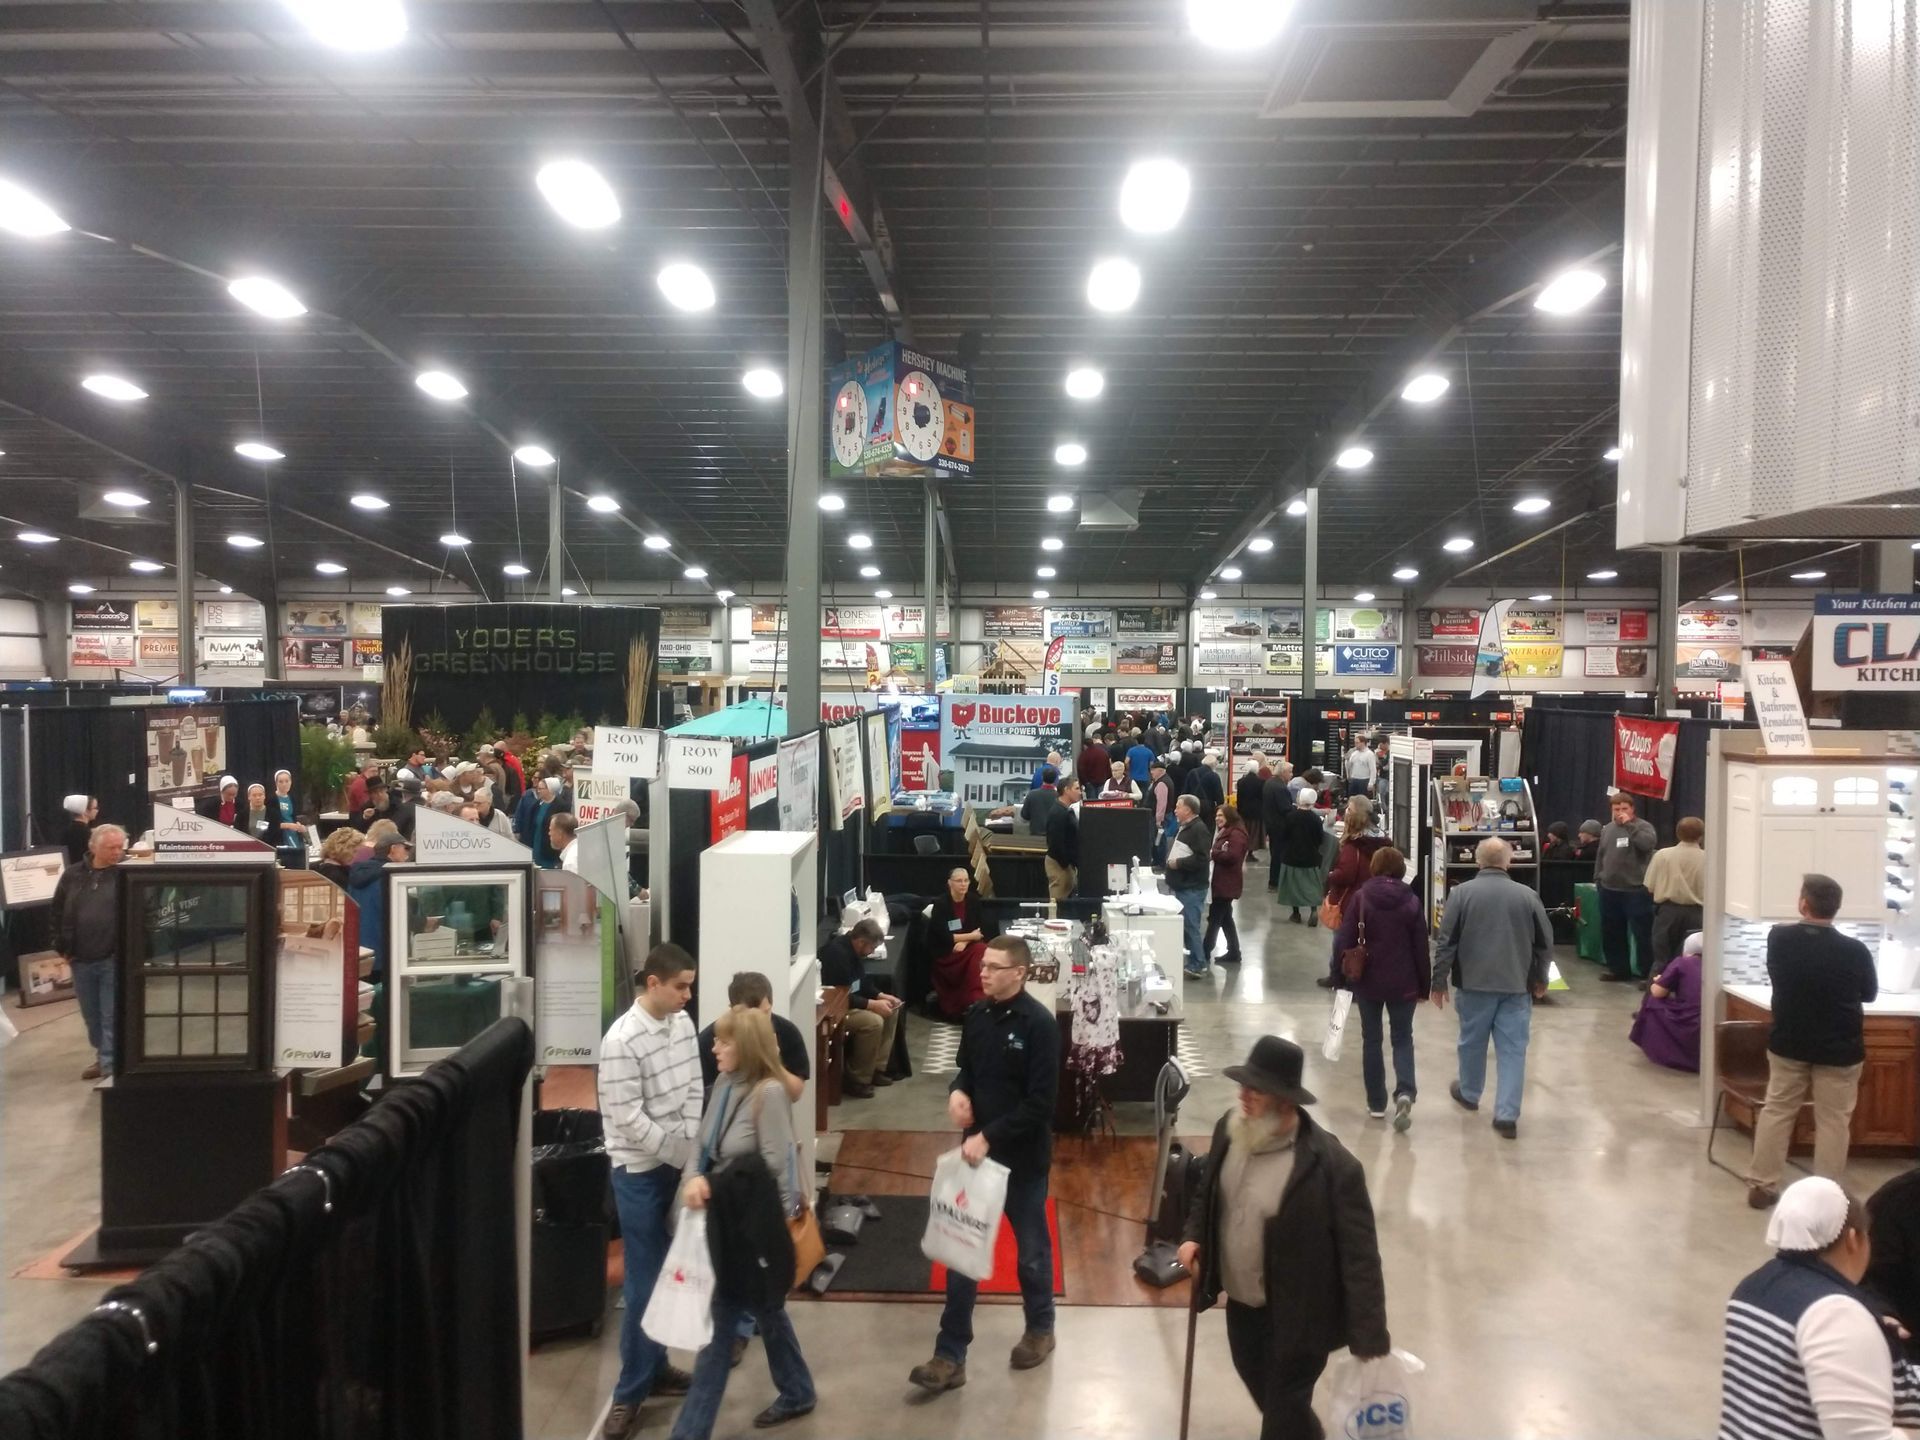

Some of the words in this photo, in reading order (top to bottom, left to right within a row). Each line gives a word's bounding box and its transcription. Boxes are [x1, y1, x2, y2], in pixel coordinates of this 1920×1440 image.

[902, 348, 934, 372] HERSHEY
[936, 361, 967, 384] MACHINE
[1831, 599, 1858, 609] Your
[1862, 597, 1907, 609] Kitchen
[455, 628, 576, 648] YODERS
[209, 642, 242, 652] NWM
[660, 643, 692, 651] MID-OHIO
[1352, 647, 1389, 658] CUTCO
[414, 651, 617, 673] GREENHOUSE
[1757, 672, 1787, 685] Kitchen
[1771, 687, 1779, 698] &
[1760, 699, 1798, 713] Bathroom
[978, 703, 1061, 725] Buckeye
[978, 727, 1007, 736] MOBILE
[1009, 727, 1036, 735] POWER
[1038, 727, 1061, 735] WASH
[607, 733, 647, 745] ROW
[1629, 731, 1652, 754] Doors
[1768, 732, 1805, 747] Company
[682, 745, 722, 758] ROW
[613, 752, 638, 764] 700
[1621, 751, 1654, 776] Windows
[688, 765, 713, 776] 800
[593, 779, 625, 797] Miller
[579, 805, 600, 820] ONE
[159, 817, 204, 837] AERIS
[159, 843, 225, 851] Maintenance-free
[422, 838, 491, 850] WINDOWS
[294, 1050, 331, 1060] ProVia
[555, 1048, 591, 1056] ProVia
